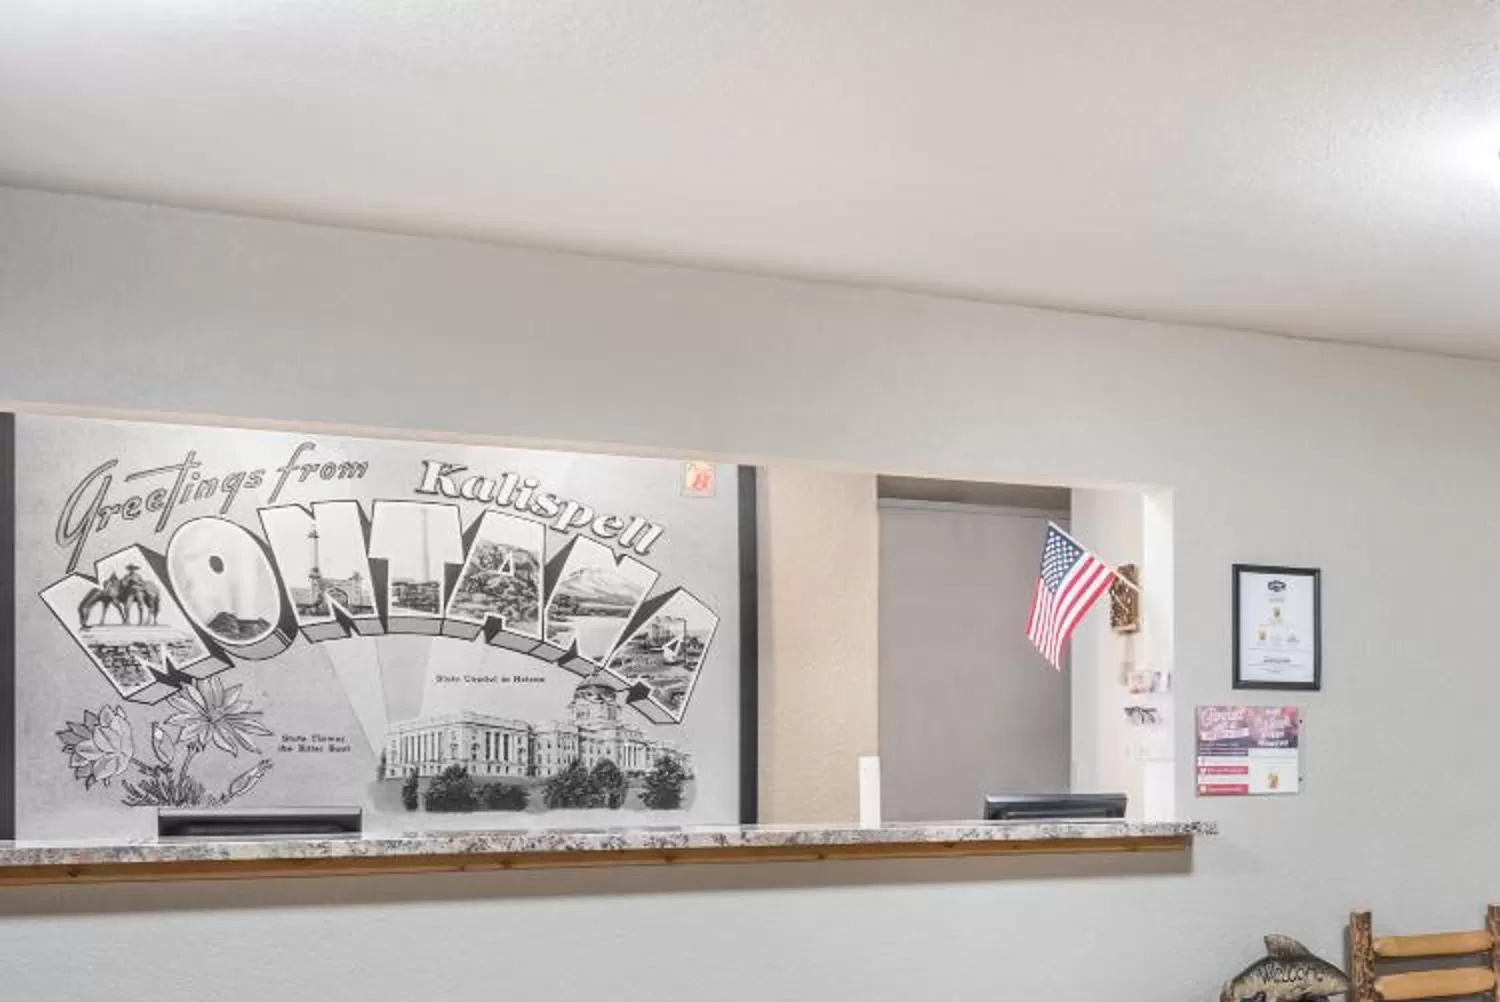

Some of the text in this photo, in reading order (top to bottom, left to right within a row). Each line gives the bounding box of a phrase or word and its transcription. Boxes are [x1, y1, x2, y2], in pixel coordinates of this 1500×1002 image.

[55, 441, 369, 575] Greetings from
[414, 458, 667, 556] Kalispell
[38, 498, 721, 725] MONTANA
